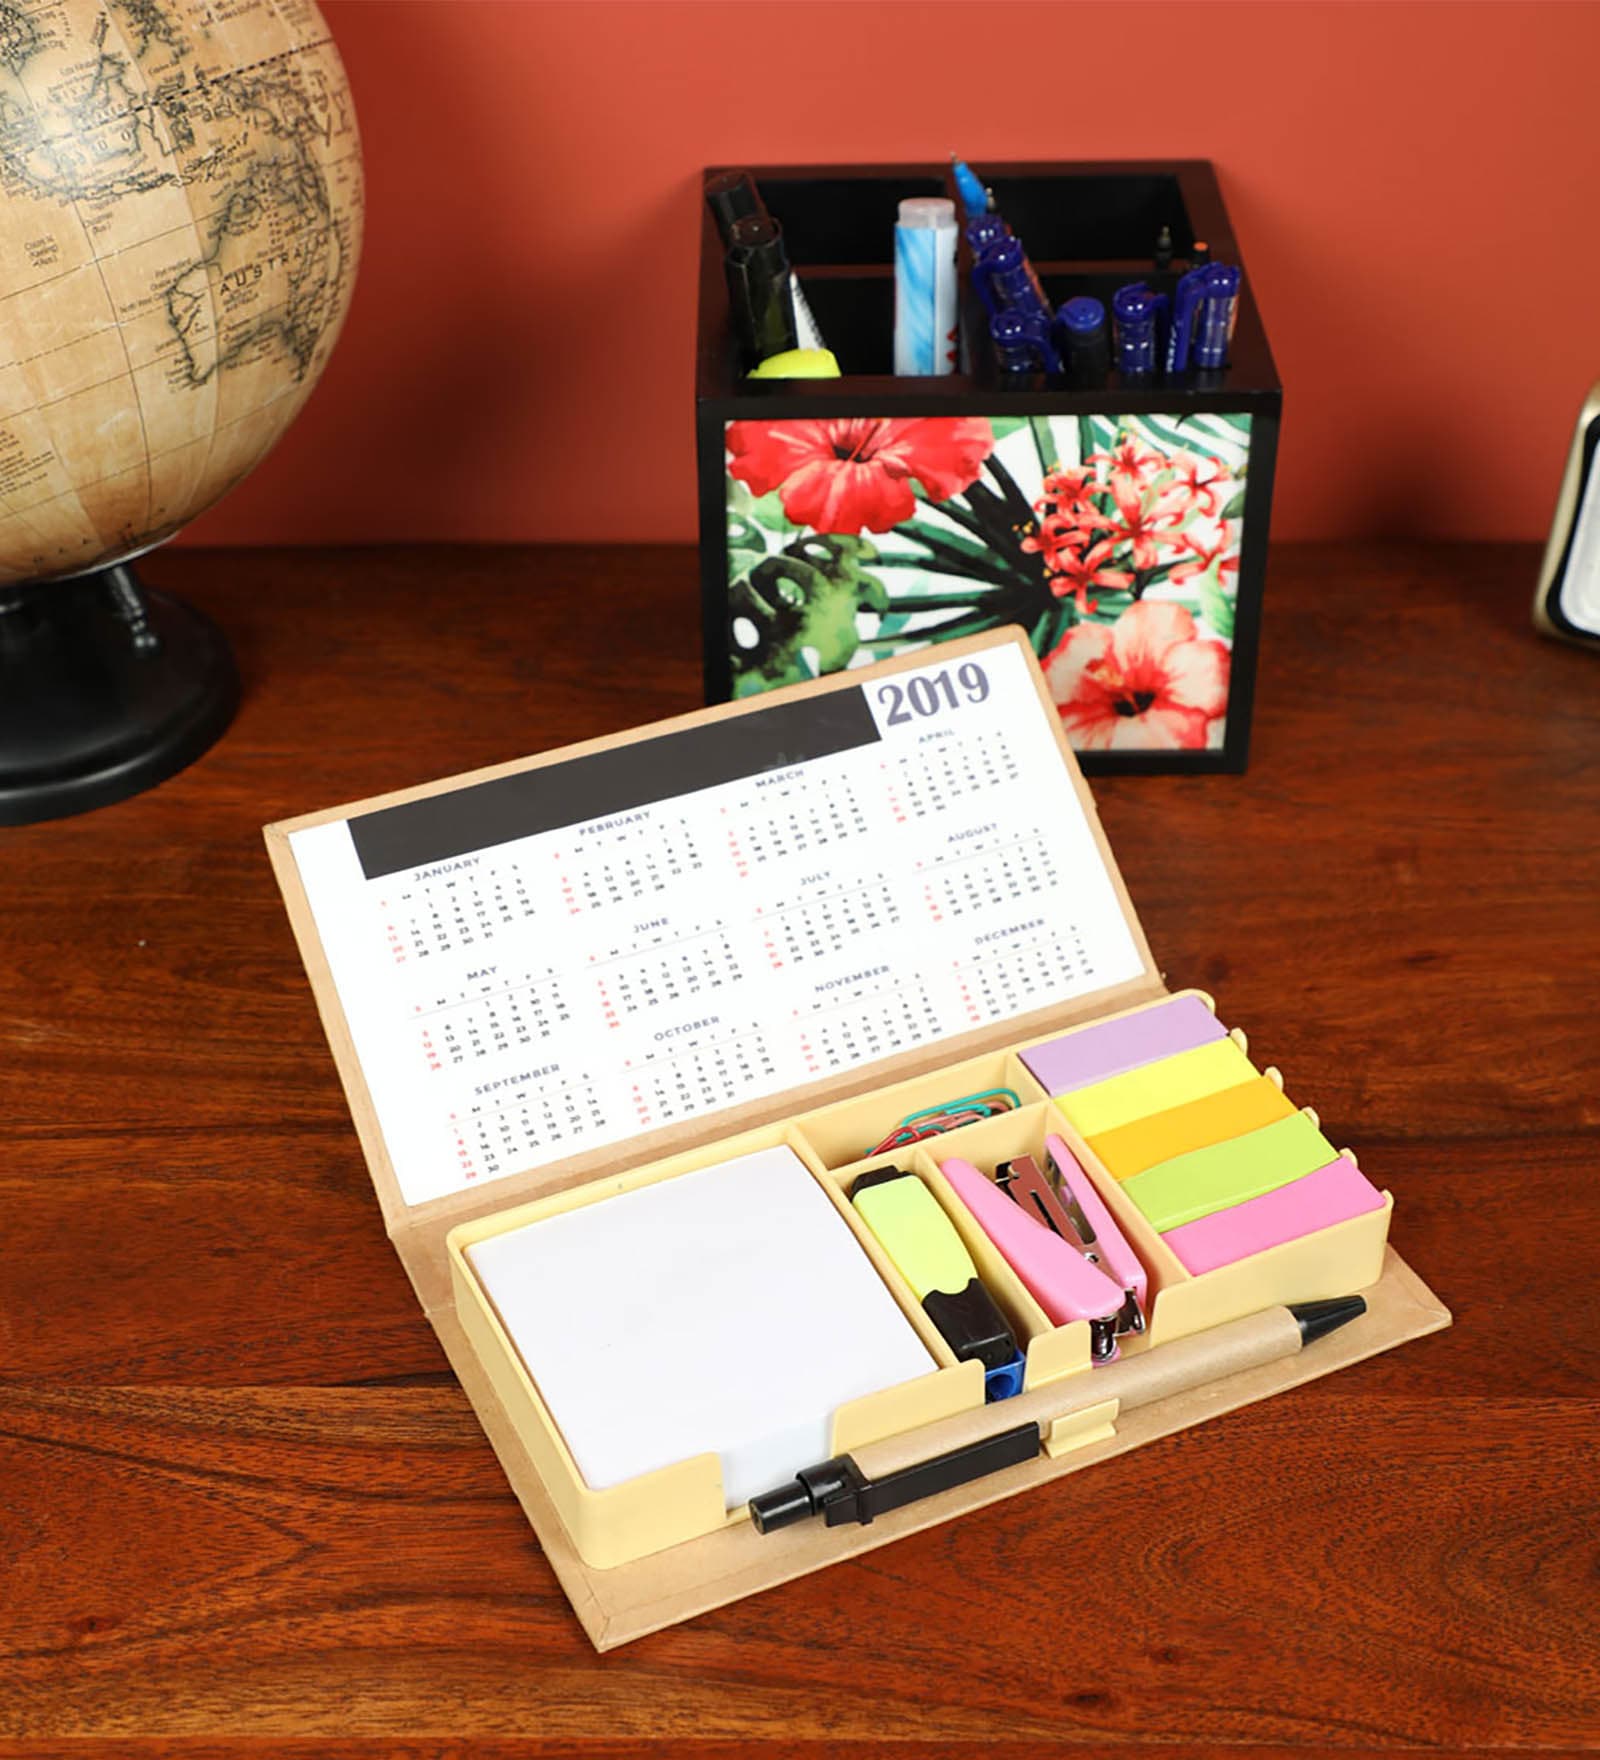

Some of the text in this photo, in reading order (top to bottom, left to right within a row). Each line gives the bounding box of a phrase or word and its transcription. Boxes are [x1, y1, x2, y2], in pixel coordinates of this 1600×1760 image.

[877, 662, 990, 727] 2019
[919, 729, 955, 743] APRIL
[756, 770, 804, 788] MARCH
[579, 811, 650, 836] FEBRUARY
[948, 823, 996, 842] AUGUST
[415, 859, 479, 881] JANUARY
[801, 871, 830, 886] JULY
[634, 917, 668, 934] JUNE
[975, 918, 1044, 945] DECEMBER
[466, 966, 497, 981] MAY
[814, 965, 889, 993] NOVEMBER
[529, 998, 541, 1006] 10
[444, 1034, 455, 1043] 13
[467, 1028, 479, 1036] 14
[489, 1021, 500, 1029] 15
[533, 1008, 543, 1017] 17
[449, 1012, 571, 1054] 20 21 22 23 24 25
[653, 1016, 720, 1041] OCTOBER
[453, 1055, 464, 1064] 27
[497, 1042, 509, 1051] 29
[519, 1035, 532, 1044] 30
[540, 1029, 551, 1038] 31
[474, 1063, 560, 1095] SEPTEMBER
[499, 1125, 510, 1133] 10
[521, 1118, 530, 1126] 11
[543, 1111, 553, 1119] 12
[565, 1105, 575, 1113] 13
[502, 1135, 512, 1144] 17
[569, 1114, 582, 1124] 20
[591, 1108, 601, 1117] 21
[484, 1152, 496, 1162] 23
[507, 1146, 519, 1155] 24
[529, 1139, 541, 1149] 25
[573, 1125, 584, 1135] 27
[487, 1164, 500, 1173] 30
